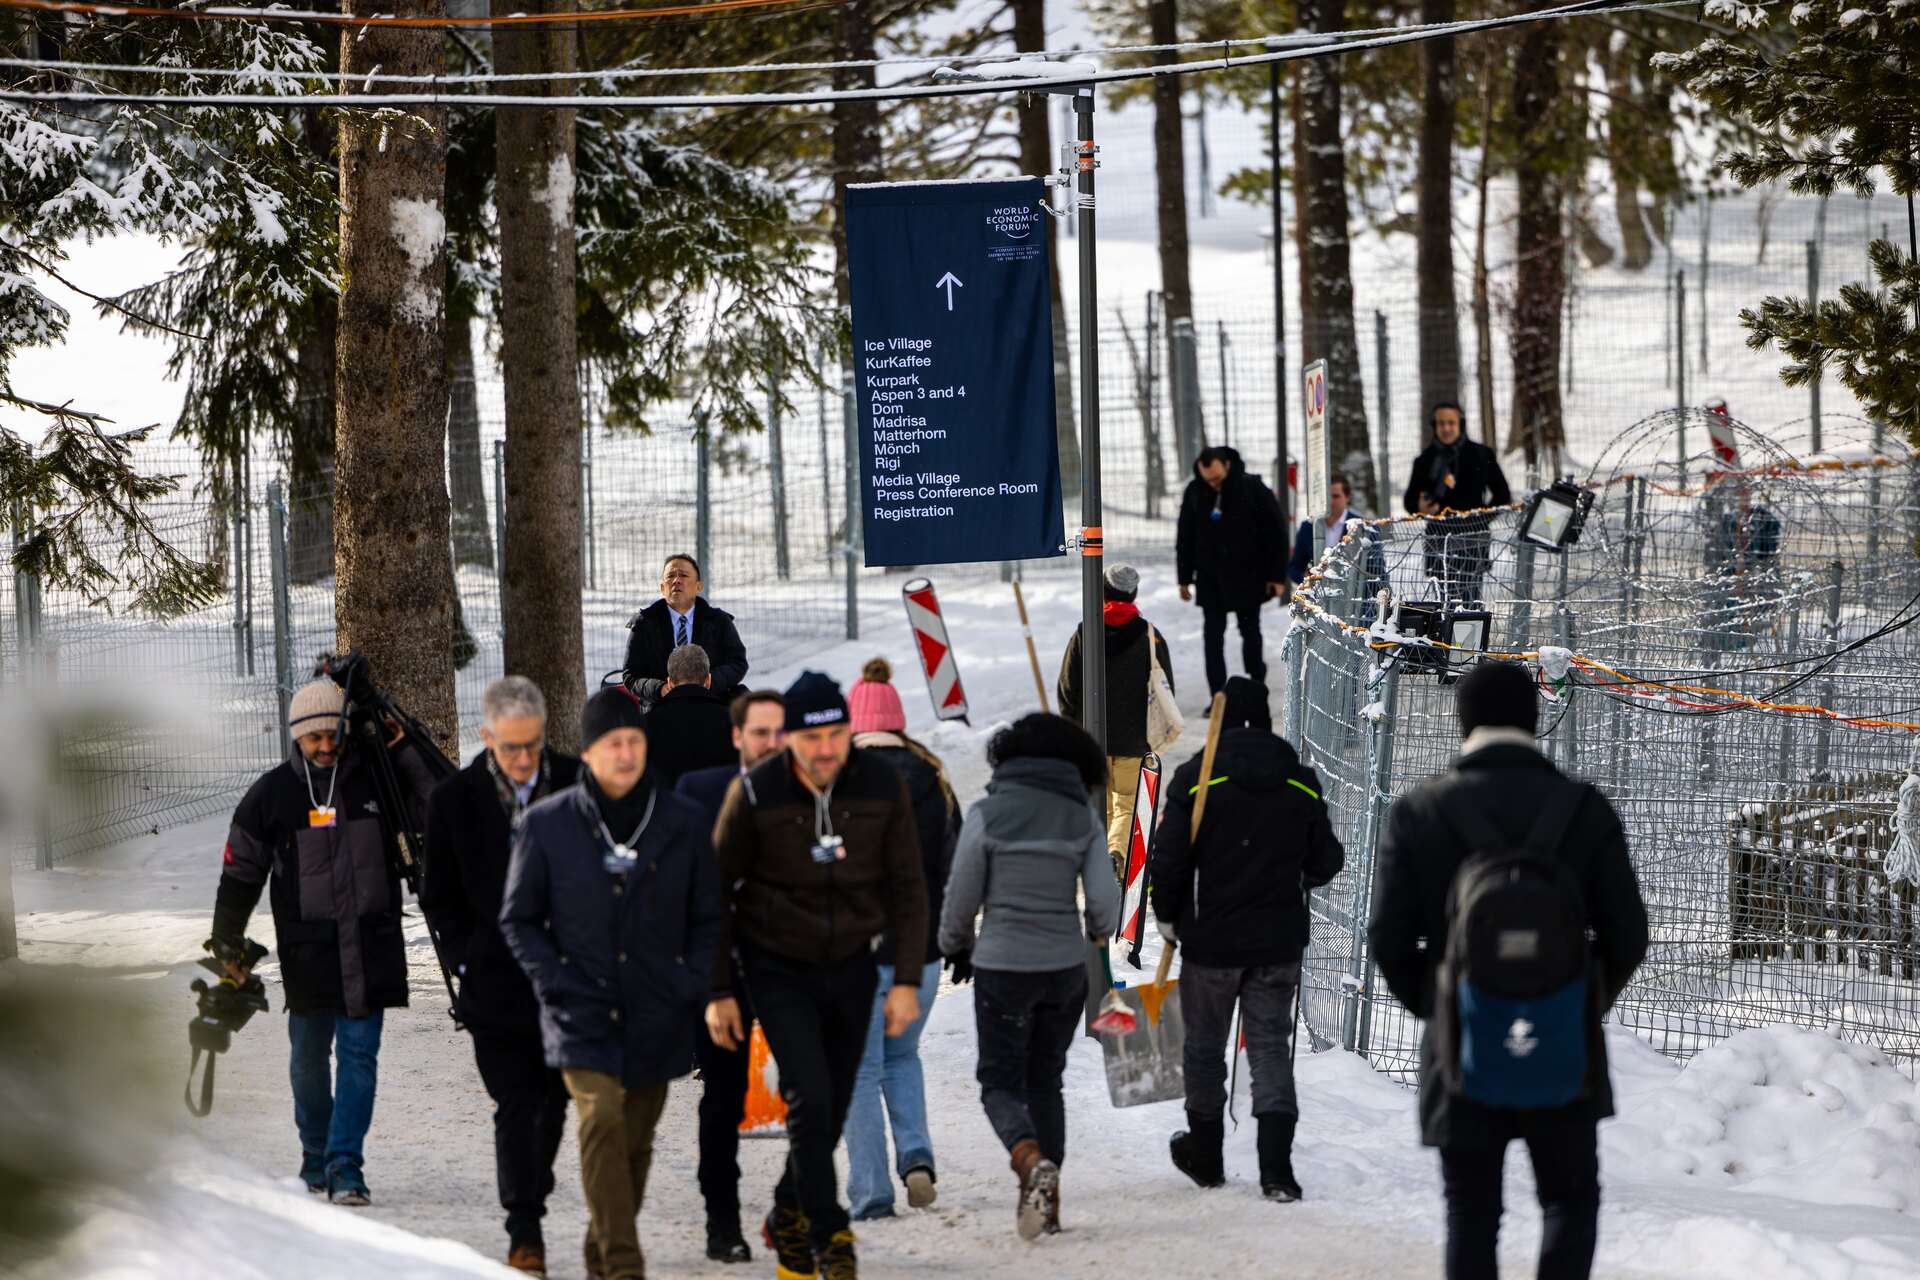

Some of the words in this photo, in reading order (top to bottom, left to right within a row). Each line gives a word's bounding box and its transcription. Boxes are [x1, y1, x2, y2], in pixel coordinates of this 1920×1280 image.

[994, 207, 1029, 215] WORLD
[986, 214, 1038, 224] ECONOMIC
[996, 223, 1029, 231] FORUM
[865, 340, 884, 351] Ice
[888, 338, 932, 351] Village
[866, 356, 931, 369] KurKaffee
[867, 374, 919, 388] Kurpark
[872, 390, 913, 403] Aspen
[918, 388, 925, 399] 3
[929, 386, 953, 398] and
[958, 386, 966, 397] 4
[872, 404, 903, 415] Dom
[873, 415, 926, 428] Madrisa
[874, 428, 946, 442] Matterhorn
[875, 442, 920, 455] Mönch
[876, 456, 900, 471] Rigi
[872, 474, 913, 486] Media
[916, 472, 960, 486] Village
[877, 490, 914, 501] Press
[918, 486, 995, 499] Conference
[999, 483, 1038, 494] Room
[874, 505, 953, 521] Registration
